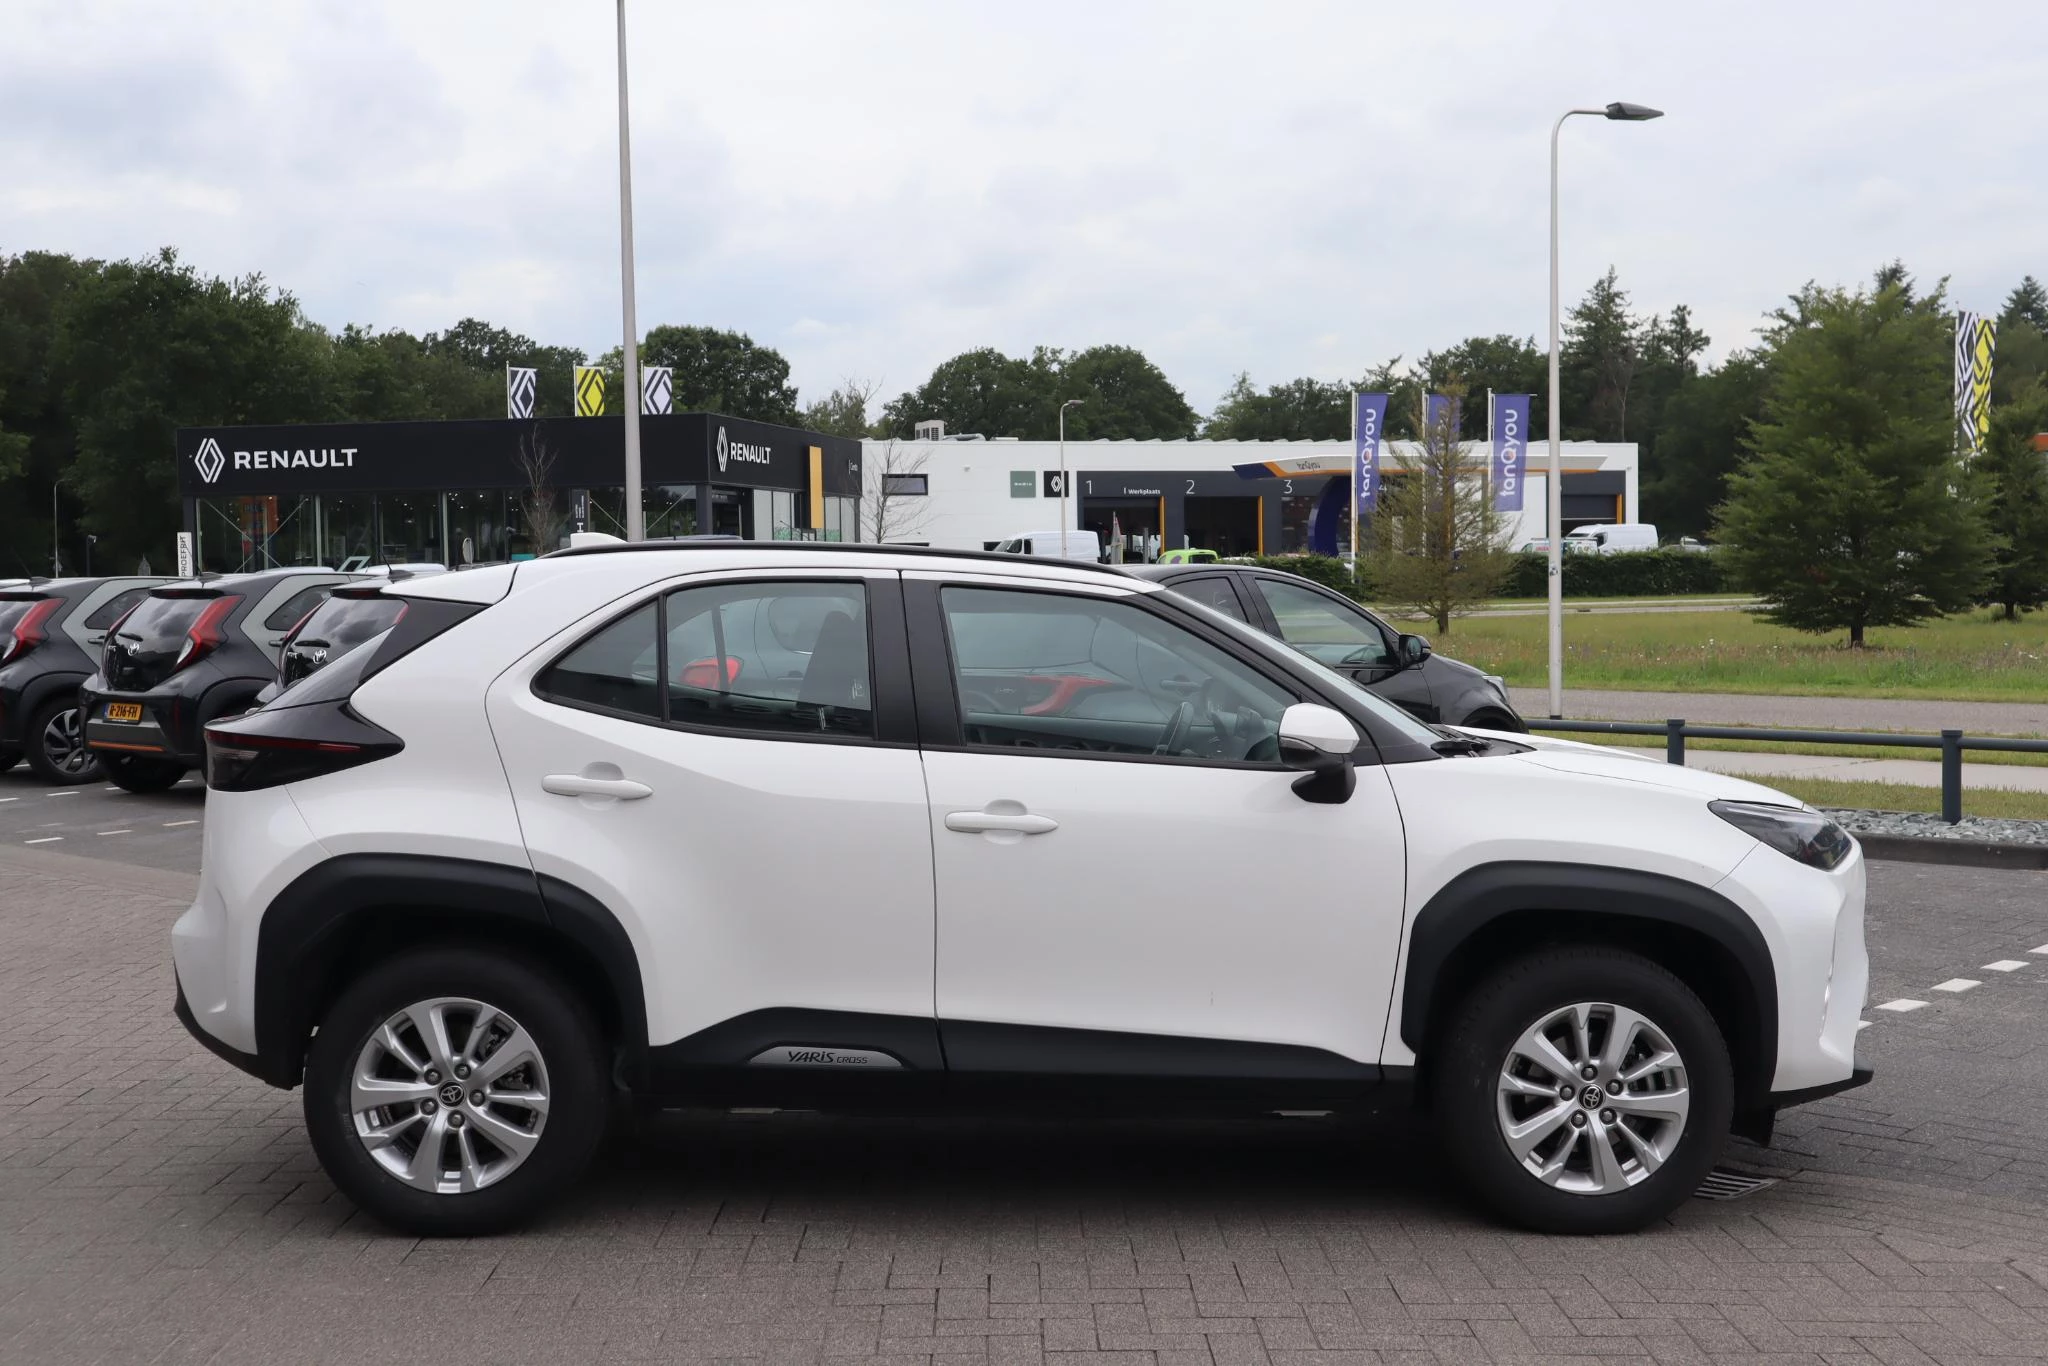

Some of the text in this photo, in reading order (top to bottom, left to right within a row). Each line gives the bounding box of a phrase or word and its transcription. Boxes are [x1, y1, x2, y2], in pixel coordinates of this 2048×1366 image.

[233, 448, 358, 470] RENAULT
[730, 442, 771, 465] RENAULT
[1360, 408, 1377, 498] tanQyou
[1500, 409, 1518, 497] tanQyou
[1086, 480, 1093, 494] 1
[1128, 487, 1161, 496] Werkplaats
[1186, 480, 1195, 494] 2
[1283, 480, 1293, 494] 3
[837, 1056, 868, 1064] CROSS
